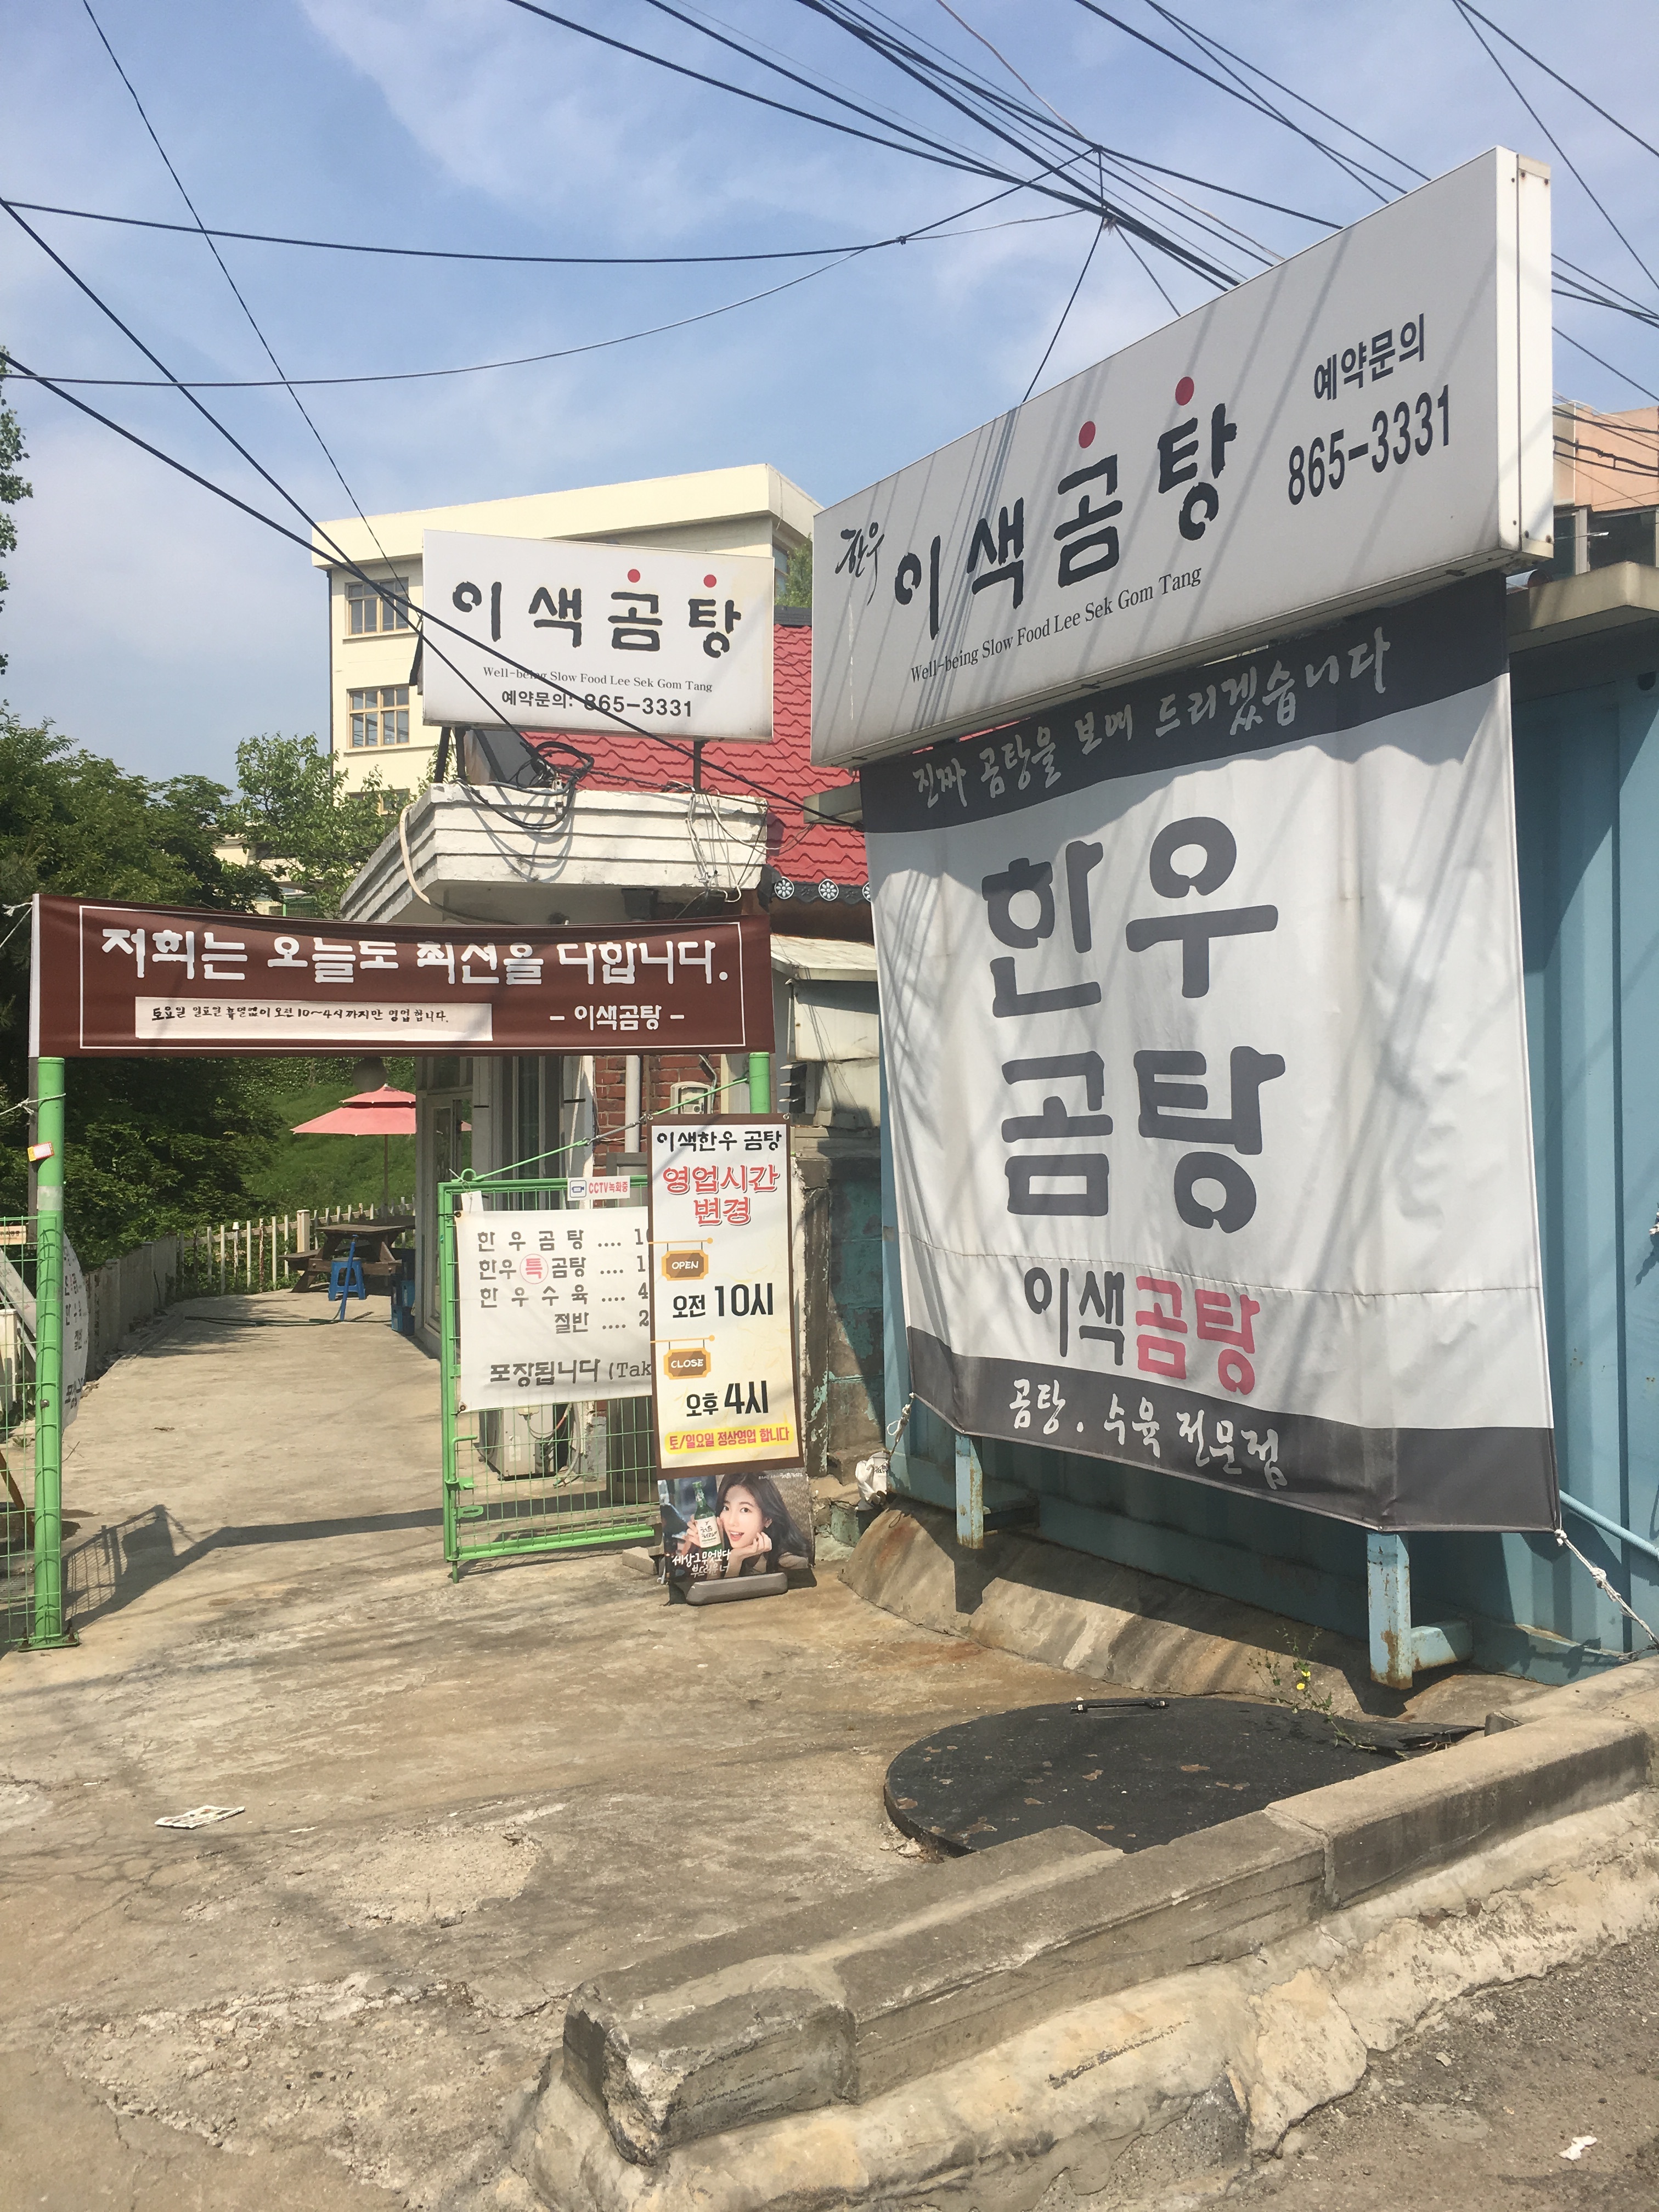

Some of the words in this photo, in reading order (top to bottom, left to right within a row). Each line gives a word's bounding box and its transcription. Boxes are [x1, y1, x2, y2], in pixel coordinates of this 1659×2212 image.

[1313, 313, 1425, 401] 예약문의
[1288, 383, 1449, 506] 865-3331
[911, 648, 979, 684] Well-being
[982, 634, 1014, 659] Slow
[1017, 618, 1051, 646] Food
[1054, 612, 1081, 634] Lee
[1085, 597, 1114, 622] Sek
[1118, 585, 1154, 610] Gom
[1158, 567, 1203, 595] Tang
[550, 671, 577, 682] Slow
[580, 673, 607, 685] Food
[610, 675, 630, 686] Lee
[633, 676, 654, 688] Sek
[657, 679, 682, 690] Gom
[685, 680, 713, 693] Tang
[583, 693, 691, 718] 865-3331
[912, 758, 968, 809] 진짜
[979, 726, 1062, 799] 곰탕을
[981, 815, 1279, 1019] 한우
[101, 928, 249, 980] 저희는
[267, 936, 399, 983] 오늘도
[416, 940, 544, 985] 최선을
[556, 940, 729, 985] 다합니다.
[151, 1006, 187, 1022] 토요일
[574, 1005, 662, 1031] 이색곰탕
[656, 1130, 737, 1153] 이색한우
[743, 1130, 782, 1152] 곰탕
[1001, 1046, 1286, 1234] 곰탕
[662, 1164, 781, 1196] 영업시간
[693, 1196, 752, 1227] 변경
[671, 1260, 699, 1270] OPEN
[672, 1294, 707, 1318] 오전
[714, 1282, 774, 1317] 10시
[554, 1311, 589, 1334] 절반
[490, 1358, 601, 1387] 포장됩니다
[670, 1358, 704, 1369] CLOSE
[686, 1392, 719, 1417] 오후
[724, 1380, 769, 1415] 4시
[669, 1432, 715, 1450] 토/일요일
[717, 1429, 757, 1446] 정상영업
[759, 1426, 790, 1442] 합니다
[1176, 1409, 1289, 1490] 전문점
